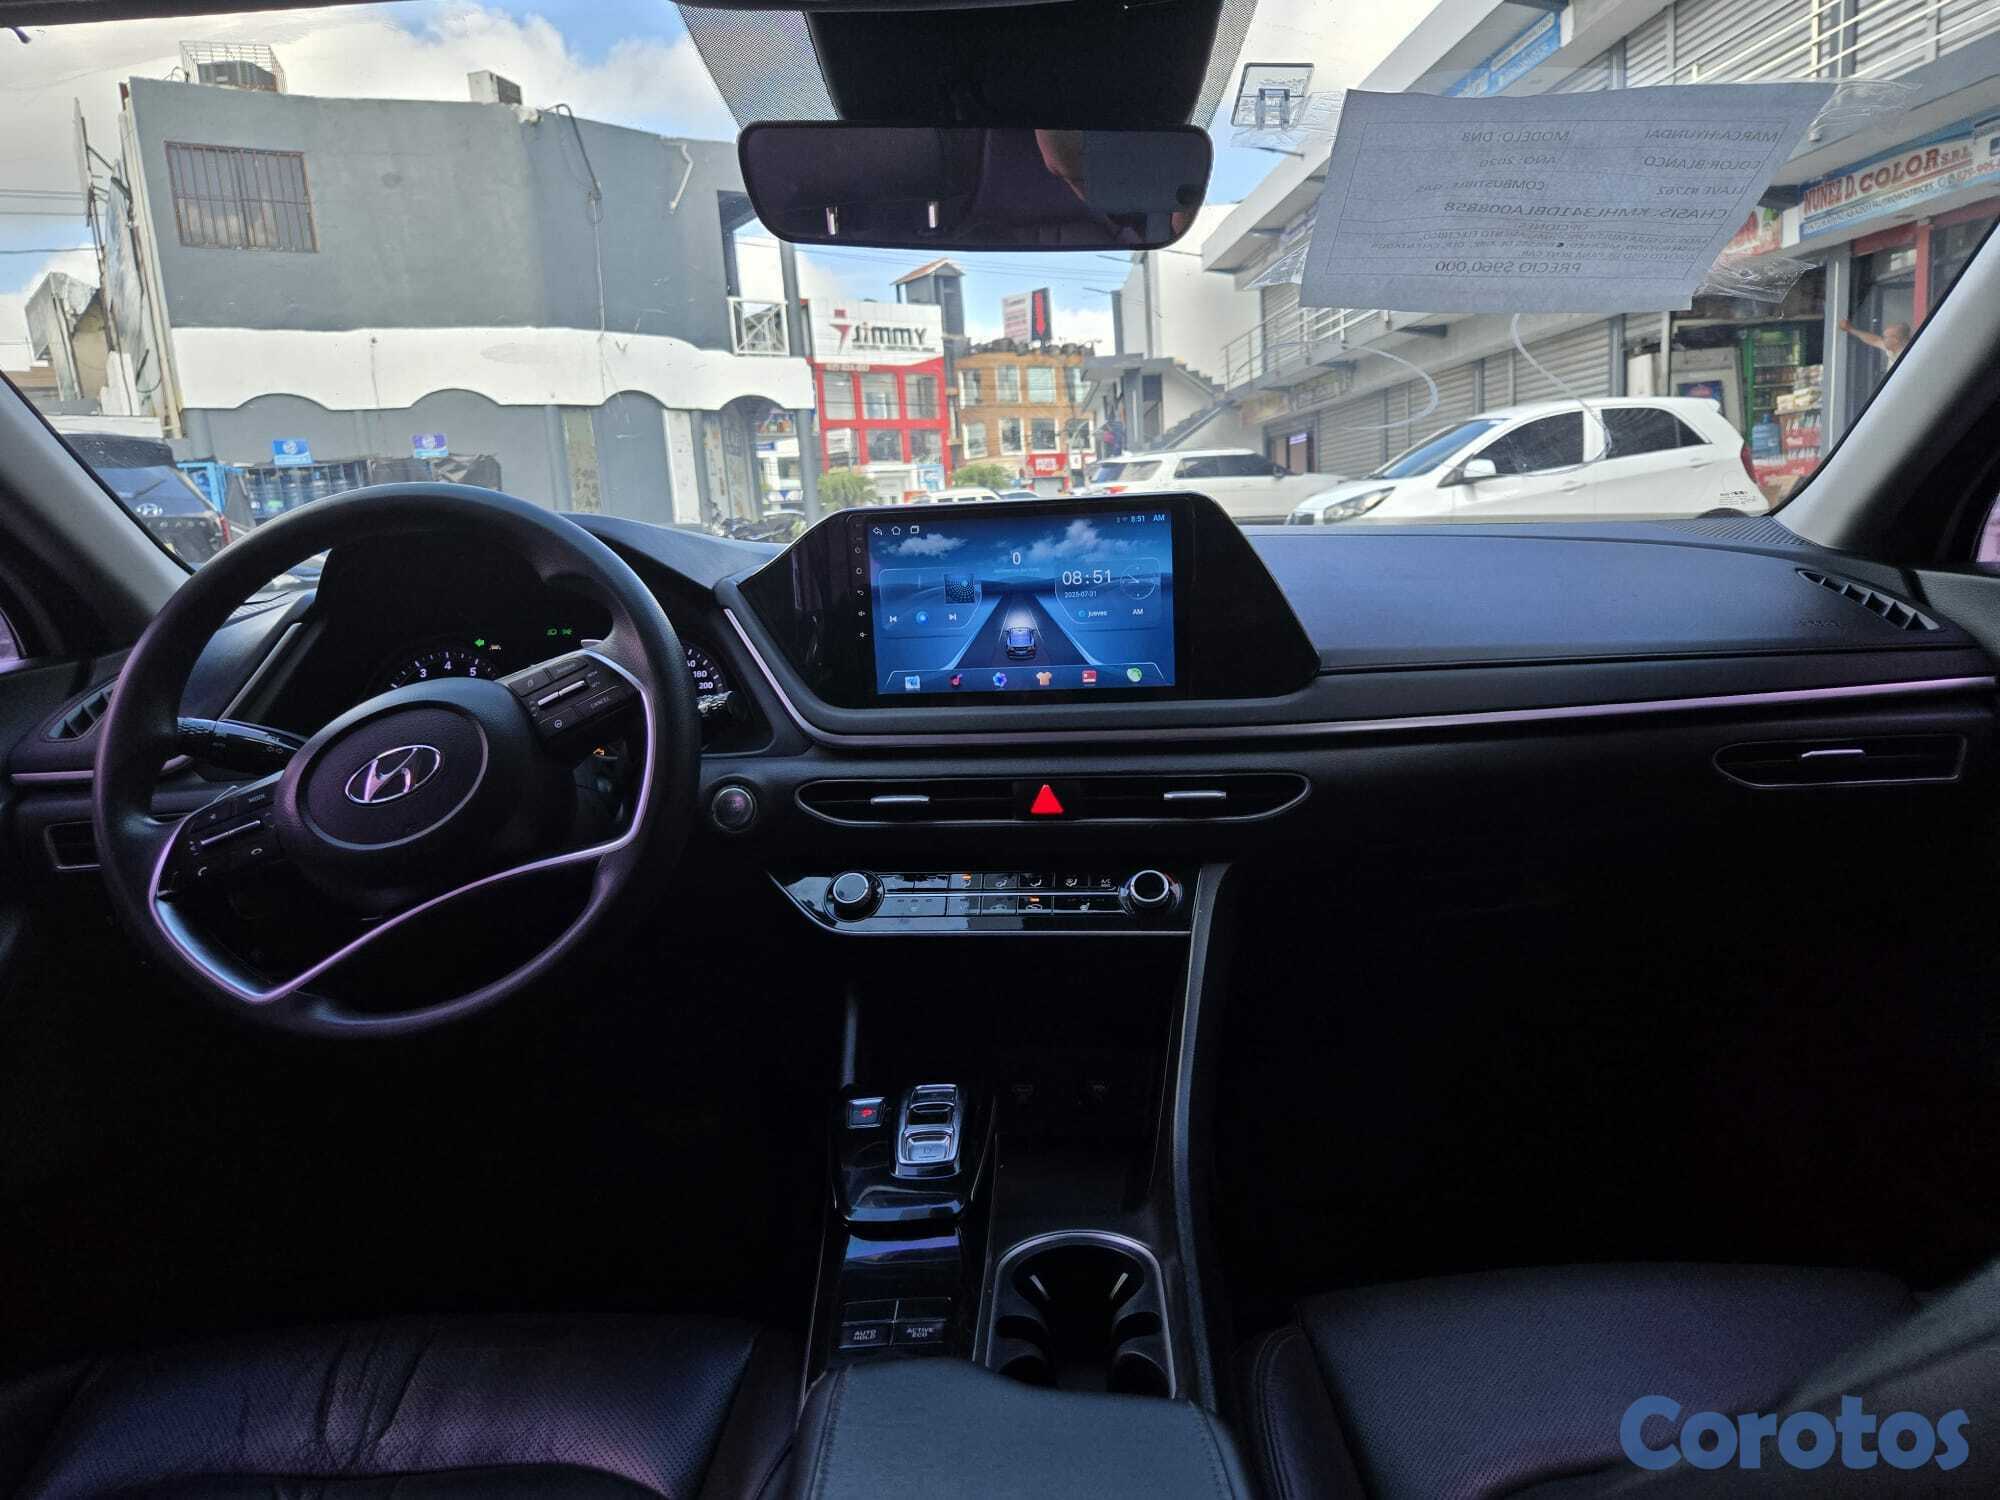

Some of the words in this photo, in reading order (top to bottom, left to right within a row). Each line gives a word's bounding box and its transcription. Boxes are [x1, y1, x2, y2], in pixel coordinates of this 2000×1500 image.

[1859, 148, 1939, 191] COLOR
[1153, 514, 1165, 522] AM
[1062, 569, 1112, 585] 08:51
[699, 682, 713, 690] 200
